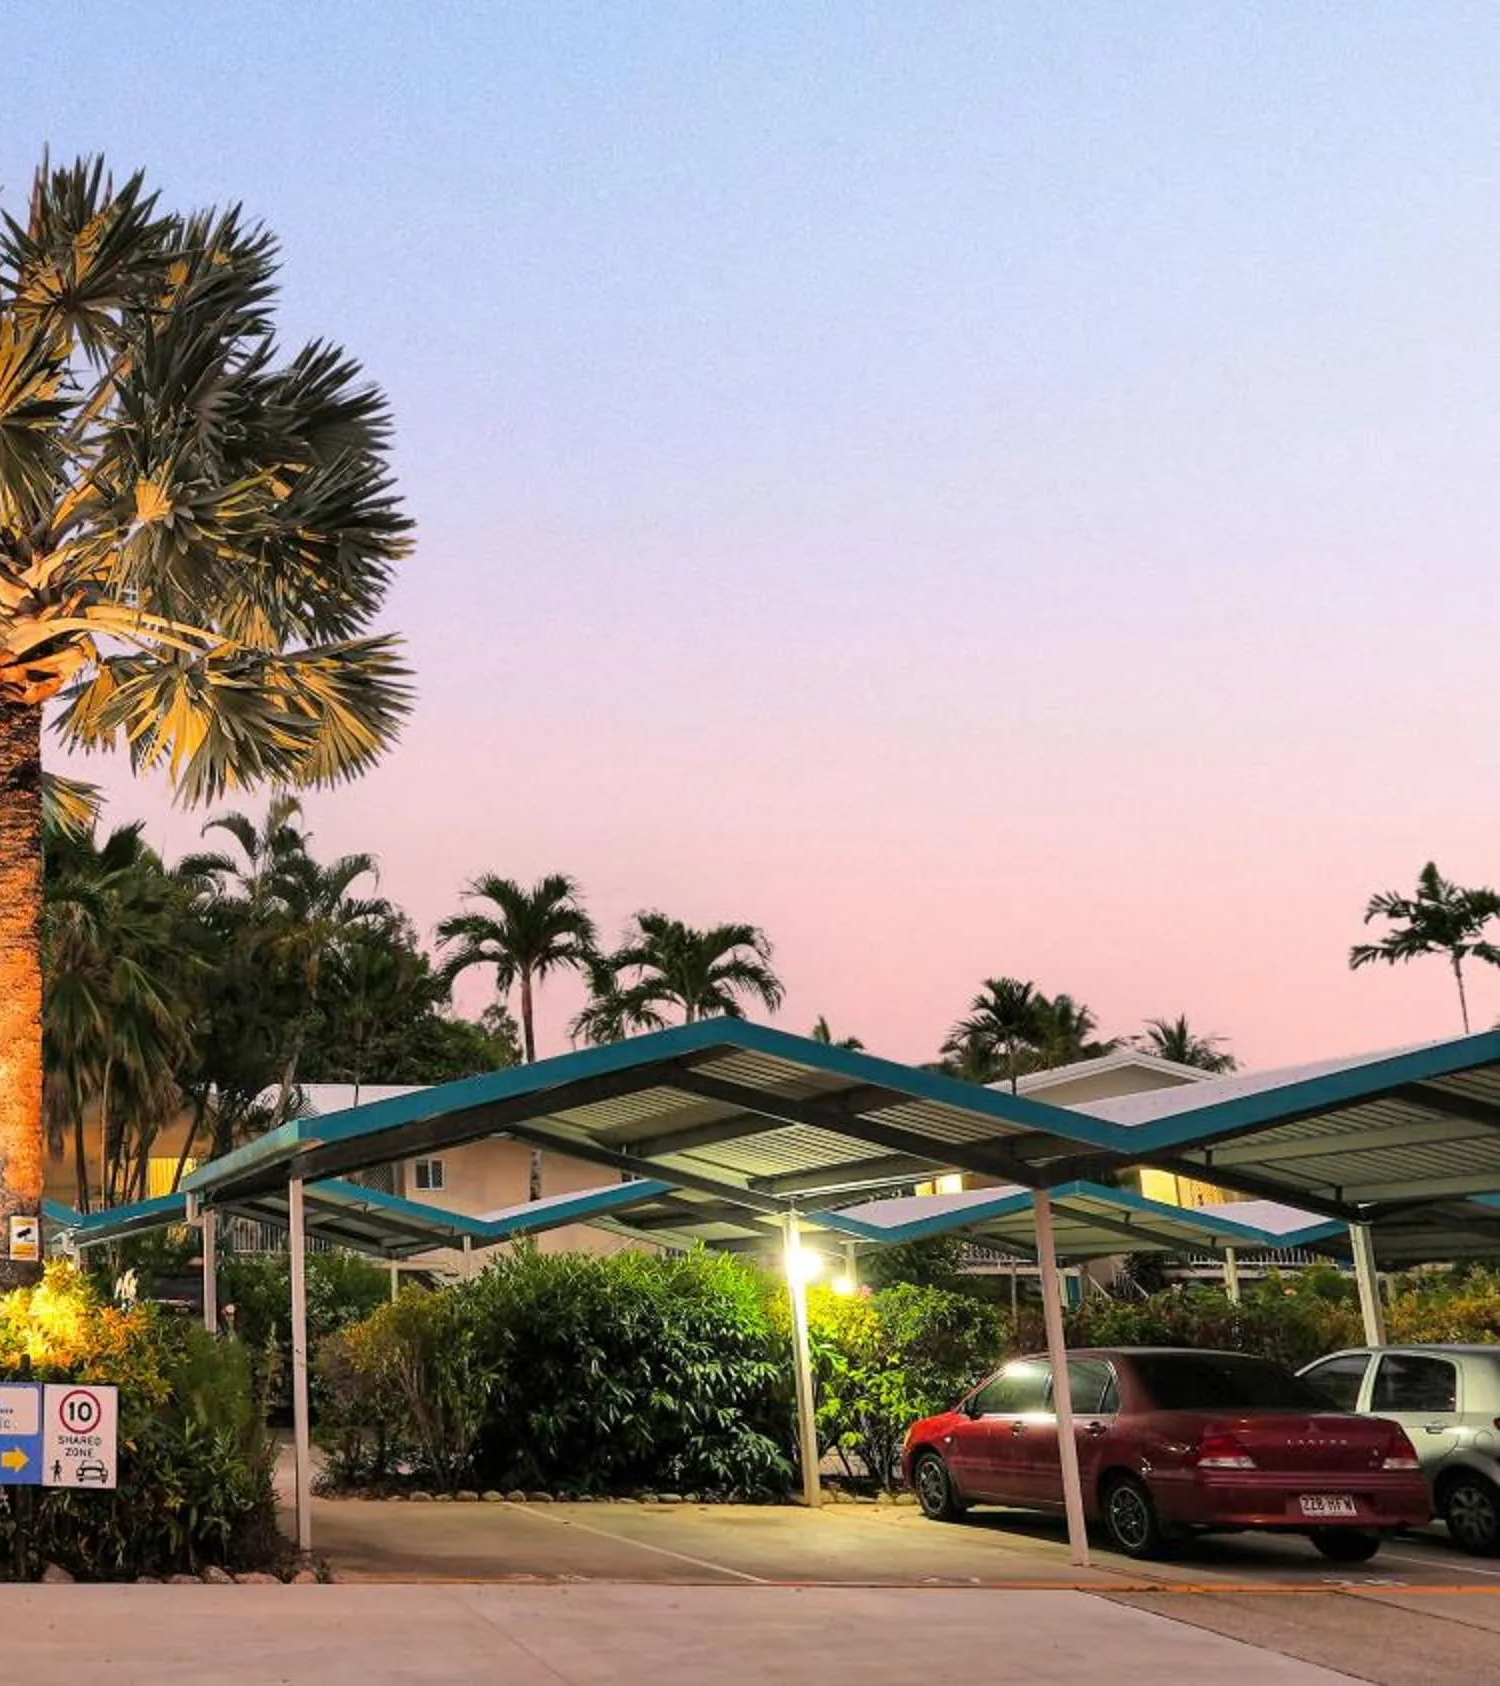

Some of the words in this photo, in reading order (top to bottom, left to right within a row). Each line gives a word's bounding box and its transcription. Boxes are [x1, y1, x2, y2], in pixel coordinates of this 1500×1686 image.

[69, 1402, 92, 1421] 10
[58, 1435, 102, 1446] SHARED
[65, 1447, 93, 1457] ZONE
